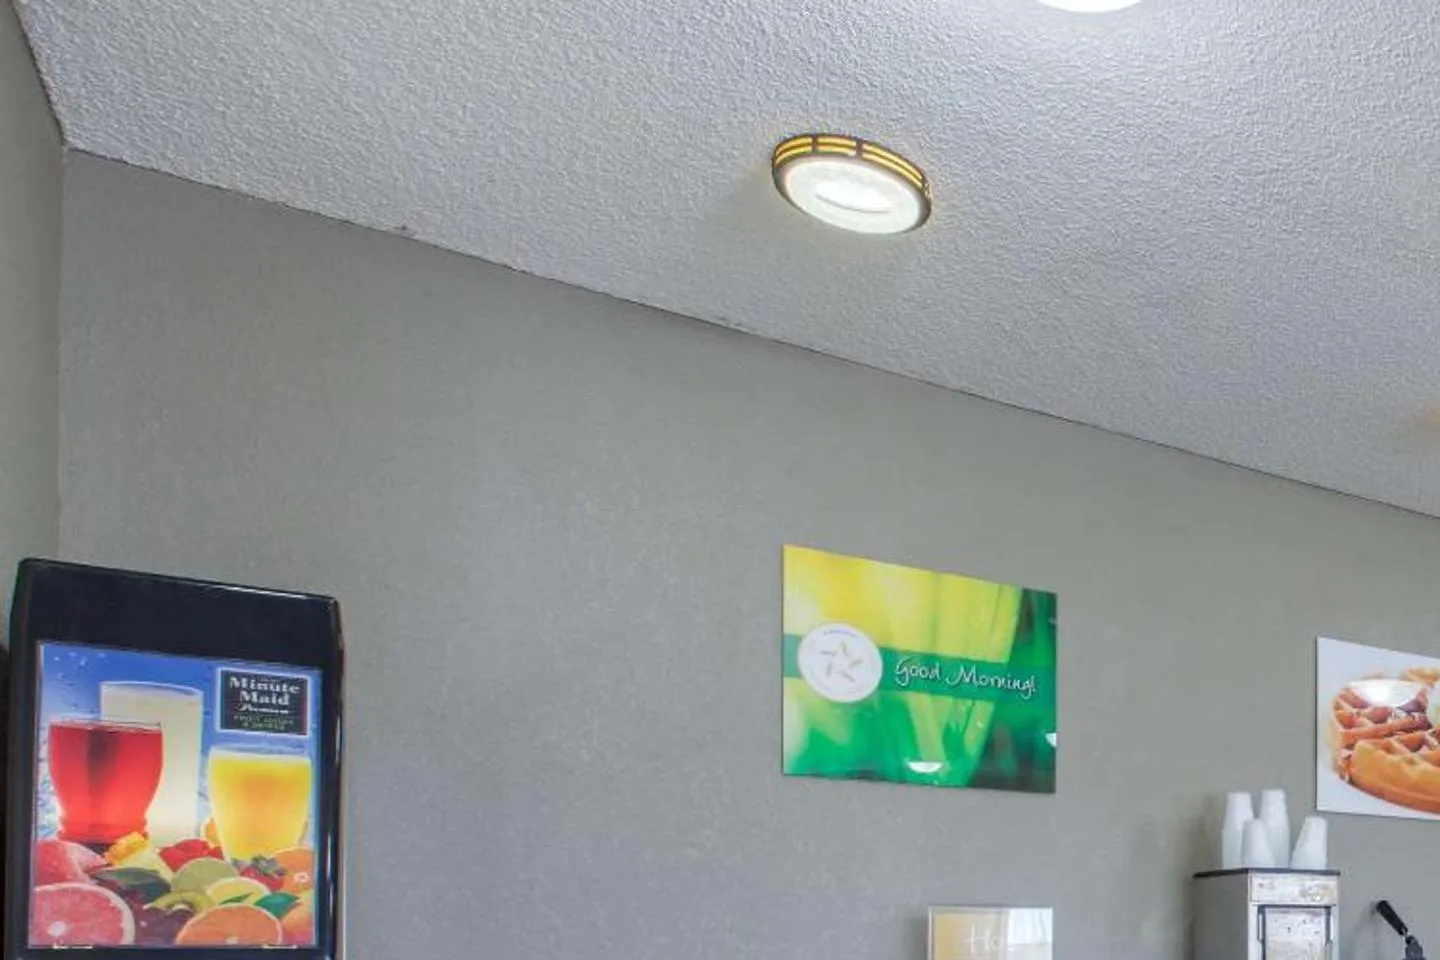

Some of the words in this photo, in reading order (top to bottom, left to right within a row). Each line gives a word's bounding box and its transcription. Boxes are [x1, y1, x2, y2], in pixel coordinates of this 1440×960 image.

[230, 676, 300, 694] Minute
[894, 656, 940, 686] Good
[945, 664, 1036, 700] Morning!
[240, 690, 290, 706] Maid
